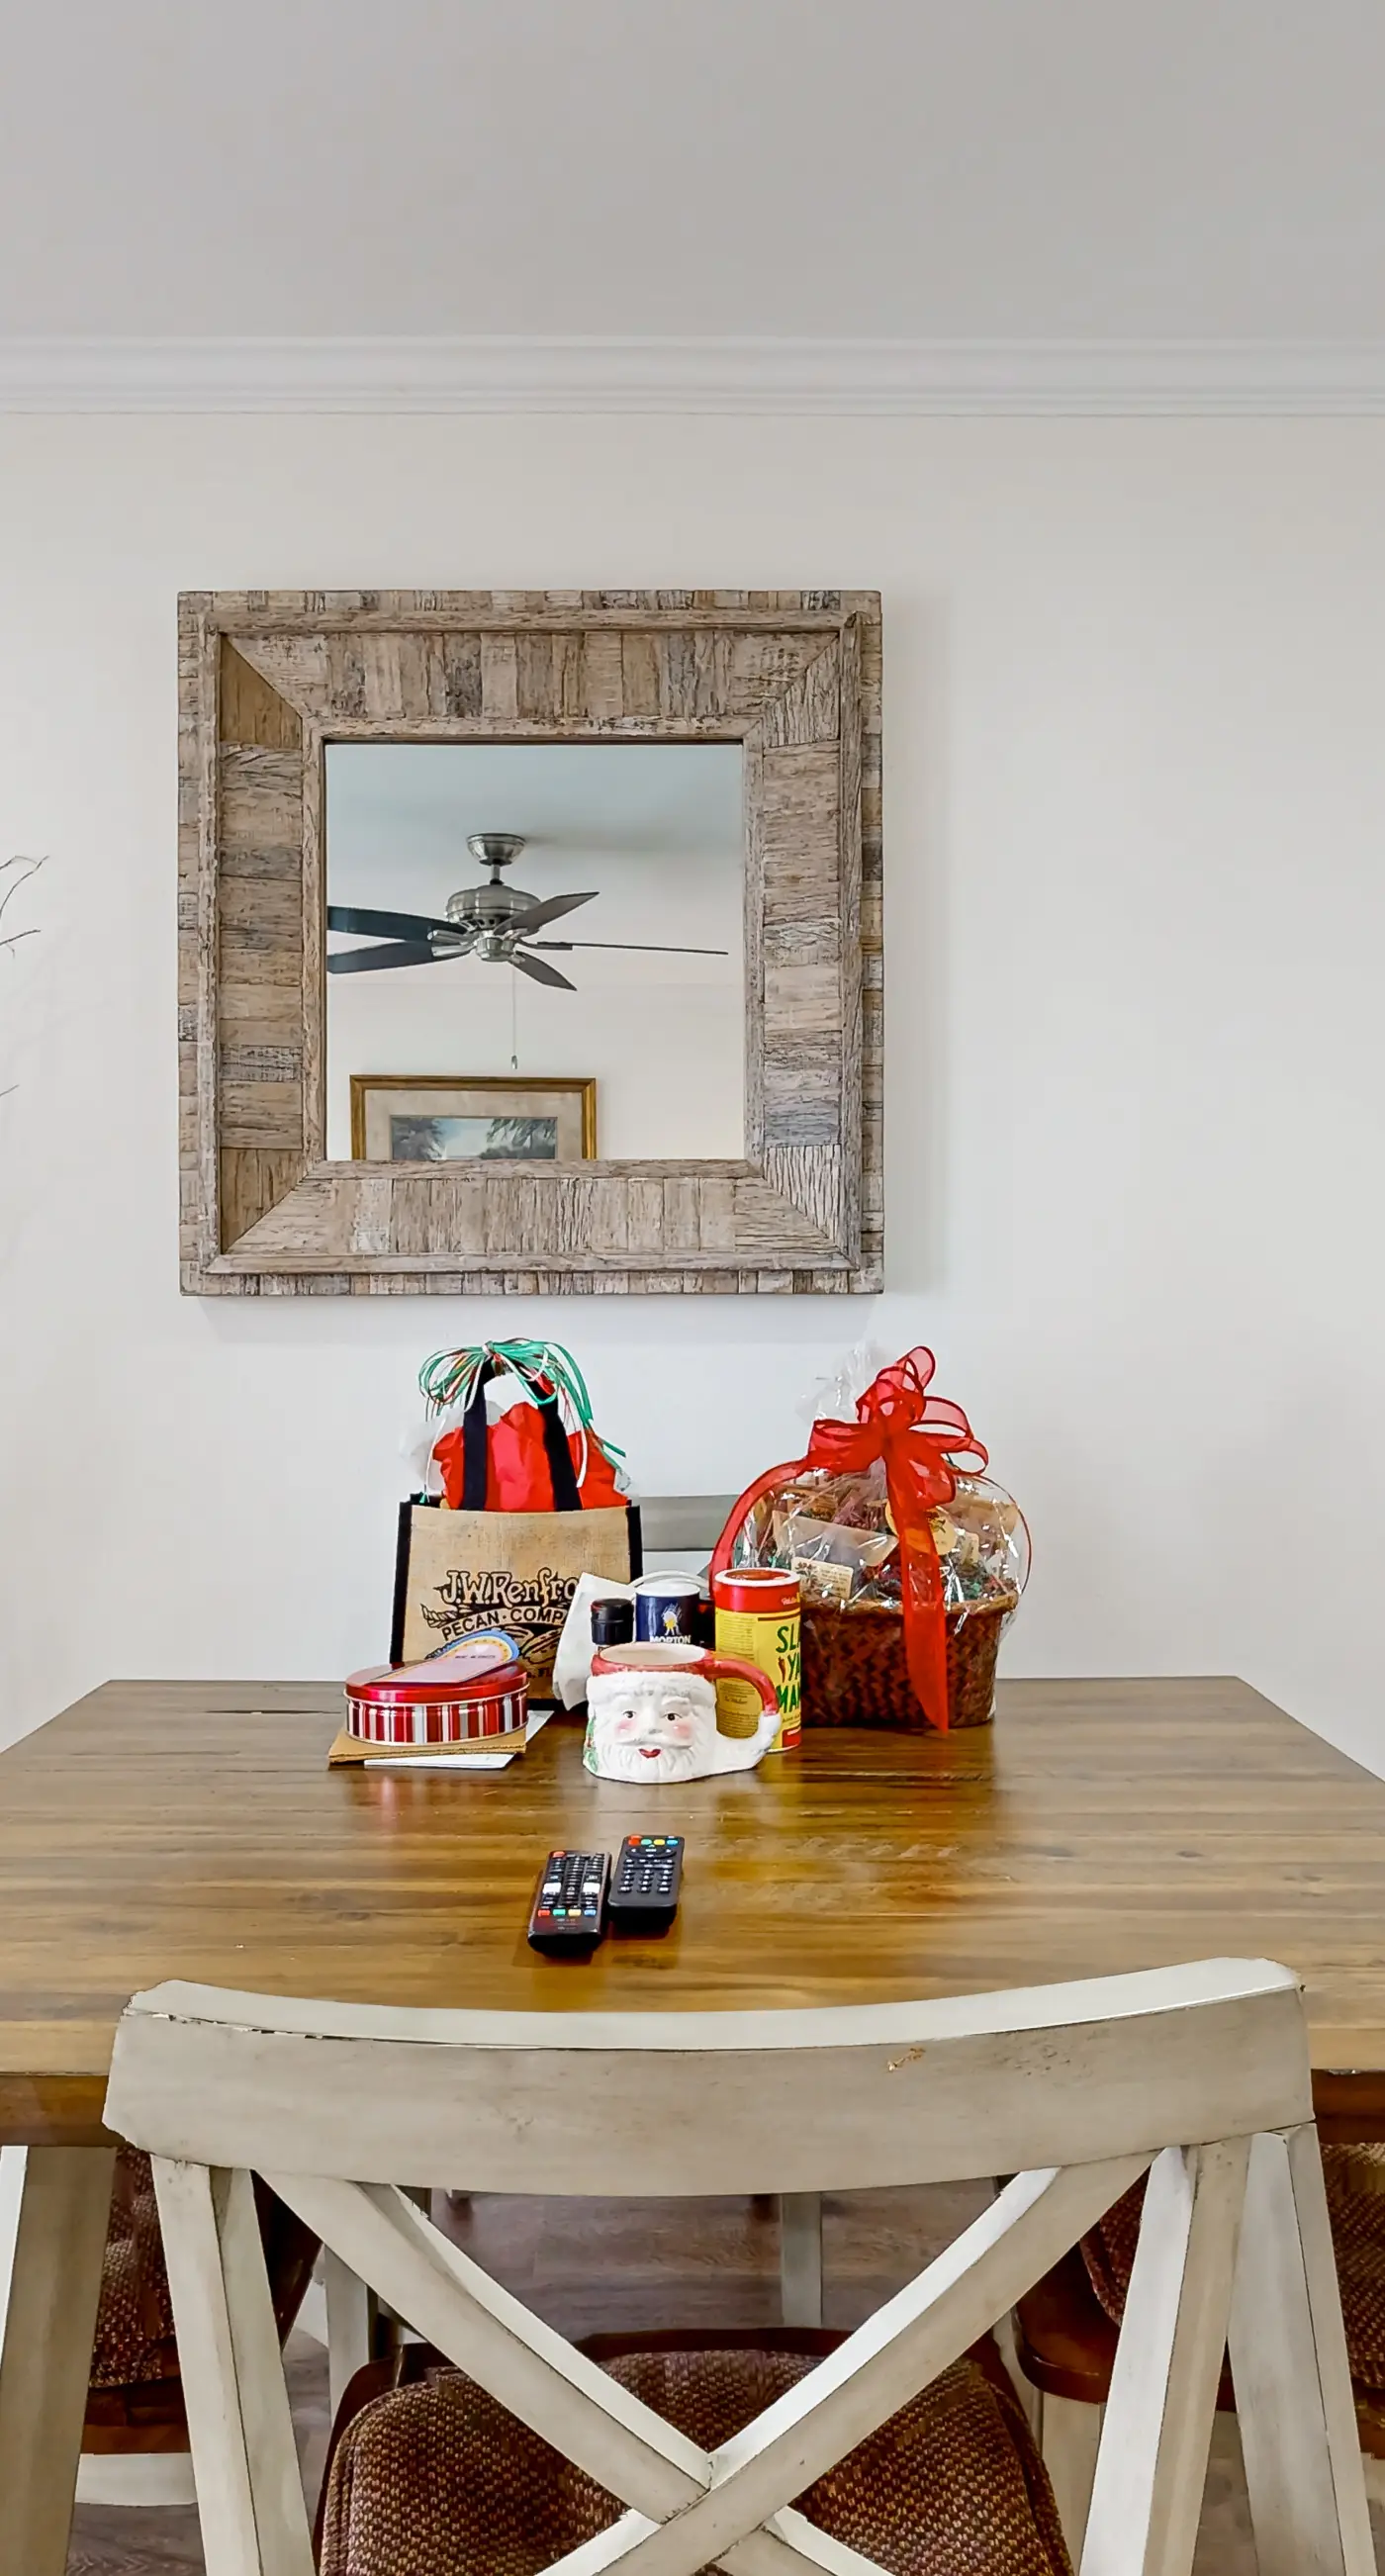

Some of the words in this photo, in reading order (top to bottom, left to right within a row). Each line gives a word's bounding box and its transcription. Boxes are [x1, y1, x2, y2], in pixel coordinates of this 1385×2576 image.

[441, 1611, 500, 1641] PECAN
[509, 1607, 568, 1623] COMP
[649, 1634, 692, 1644] MORTON
